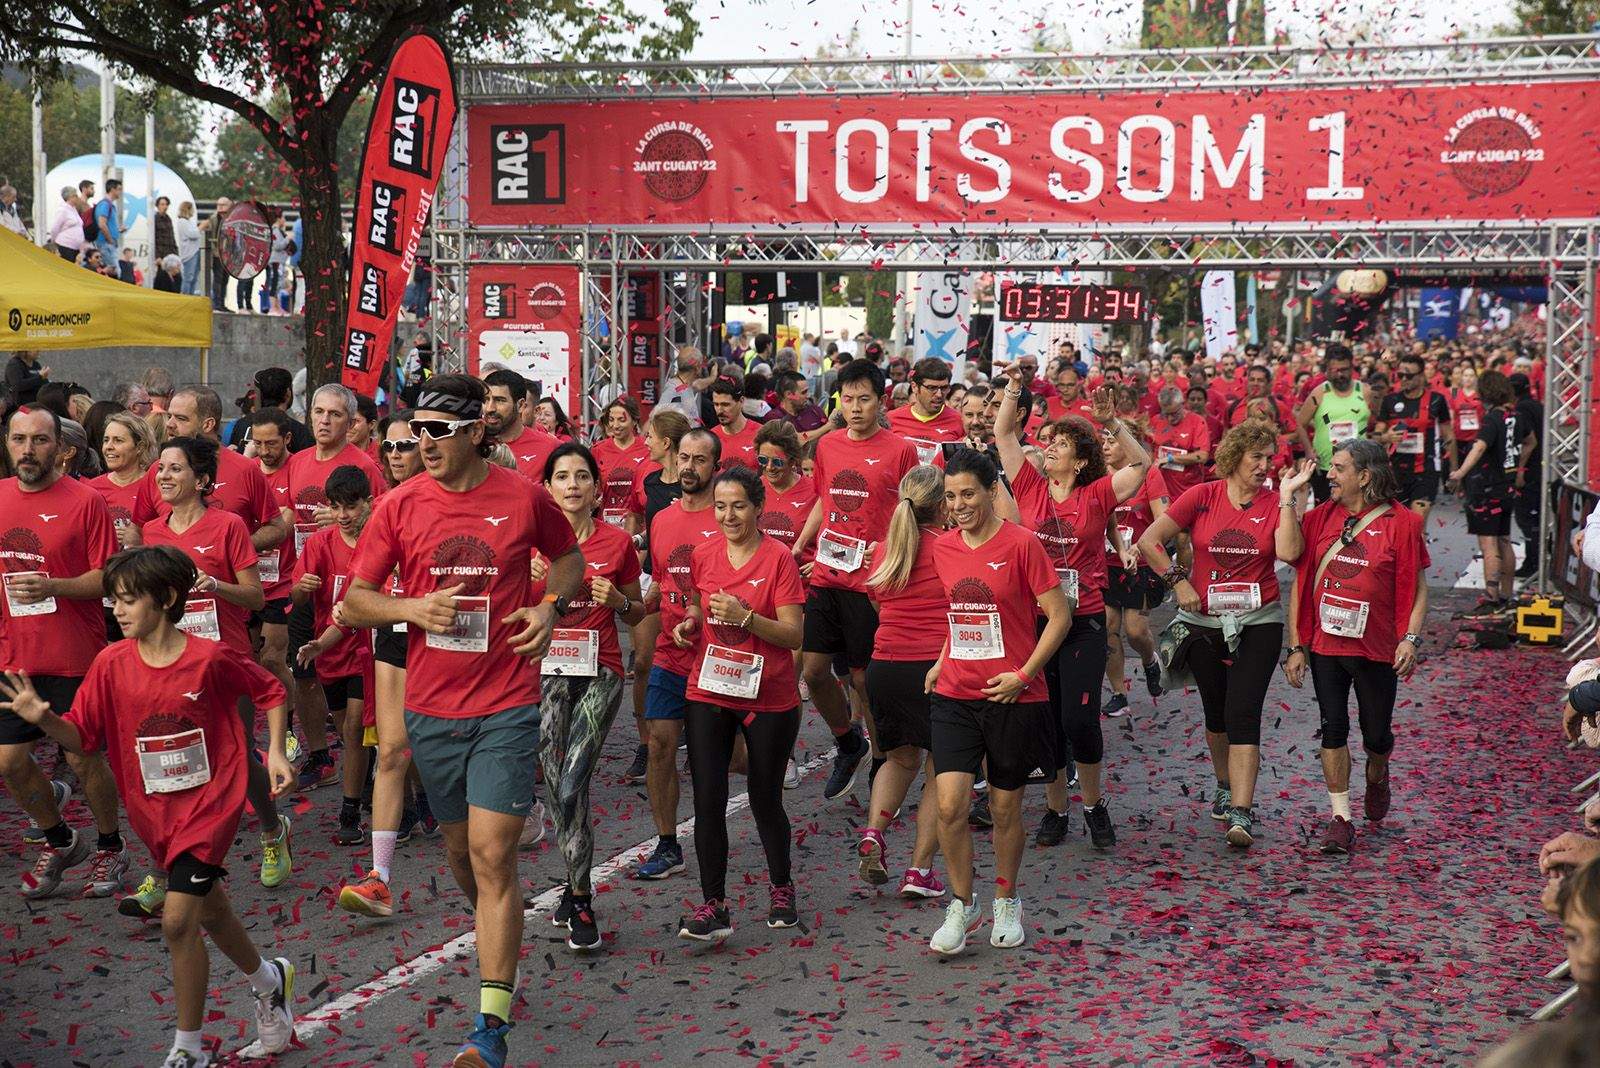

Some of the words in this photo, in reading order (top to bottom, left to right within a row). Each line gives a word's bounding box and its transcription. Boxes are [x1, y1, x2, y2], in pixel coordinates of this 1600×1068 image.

[634, 141, 646, 153] LA
[644, 120, 677, 141] CURSA
[679, 121, 693, 132] DE
[776, 117, 1012, 203] TOTS
[1047, 113, 1266, 202] SOM
[1306, 110, 1365, 200] 1
[633, 161, 662, 172] SANT
[662, 161, 699, 172] CUGAT
[1005, 288, 1140, 320] 03:31:34
[26, 312, 91, 326] CHAMPIONCHIP
[503, 322, 545, 330] #cursarac1
[1225, 547, 1249, 555] CUGAT
[429, 566, 452, 575] SANT
[452, 566, 482, 575] CUGAT
[1325, 607, 1353, 620] JAIME
[181, 614, 207, 626] LVIRA
[958, 630, 983, 642] 3043
[549, 646, 580, 657] 3062
[713, 664, 742, 679] 3044
[159, 752, 189, 767] BIEL
[163, 765, 189, 777] 1489
